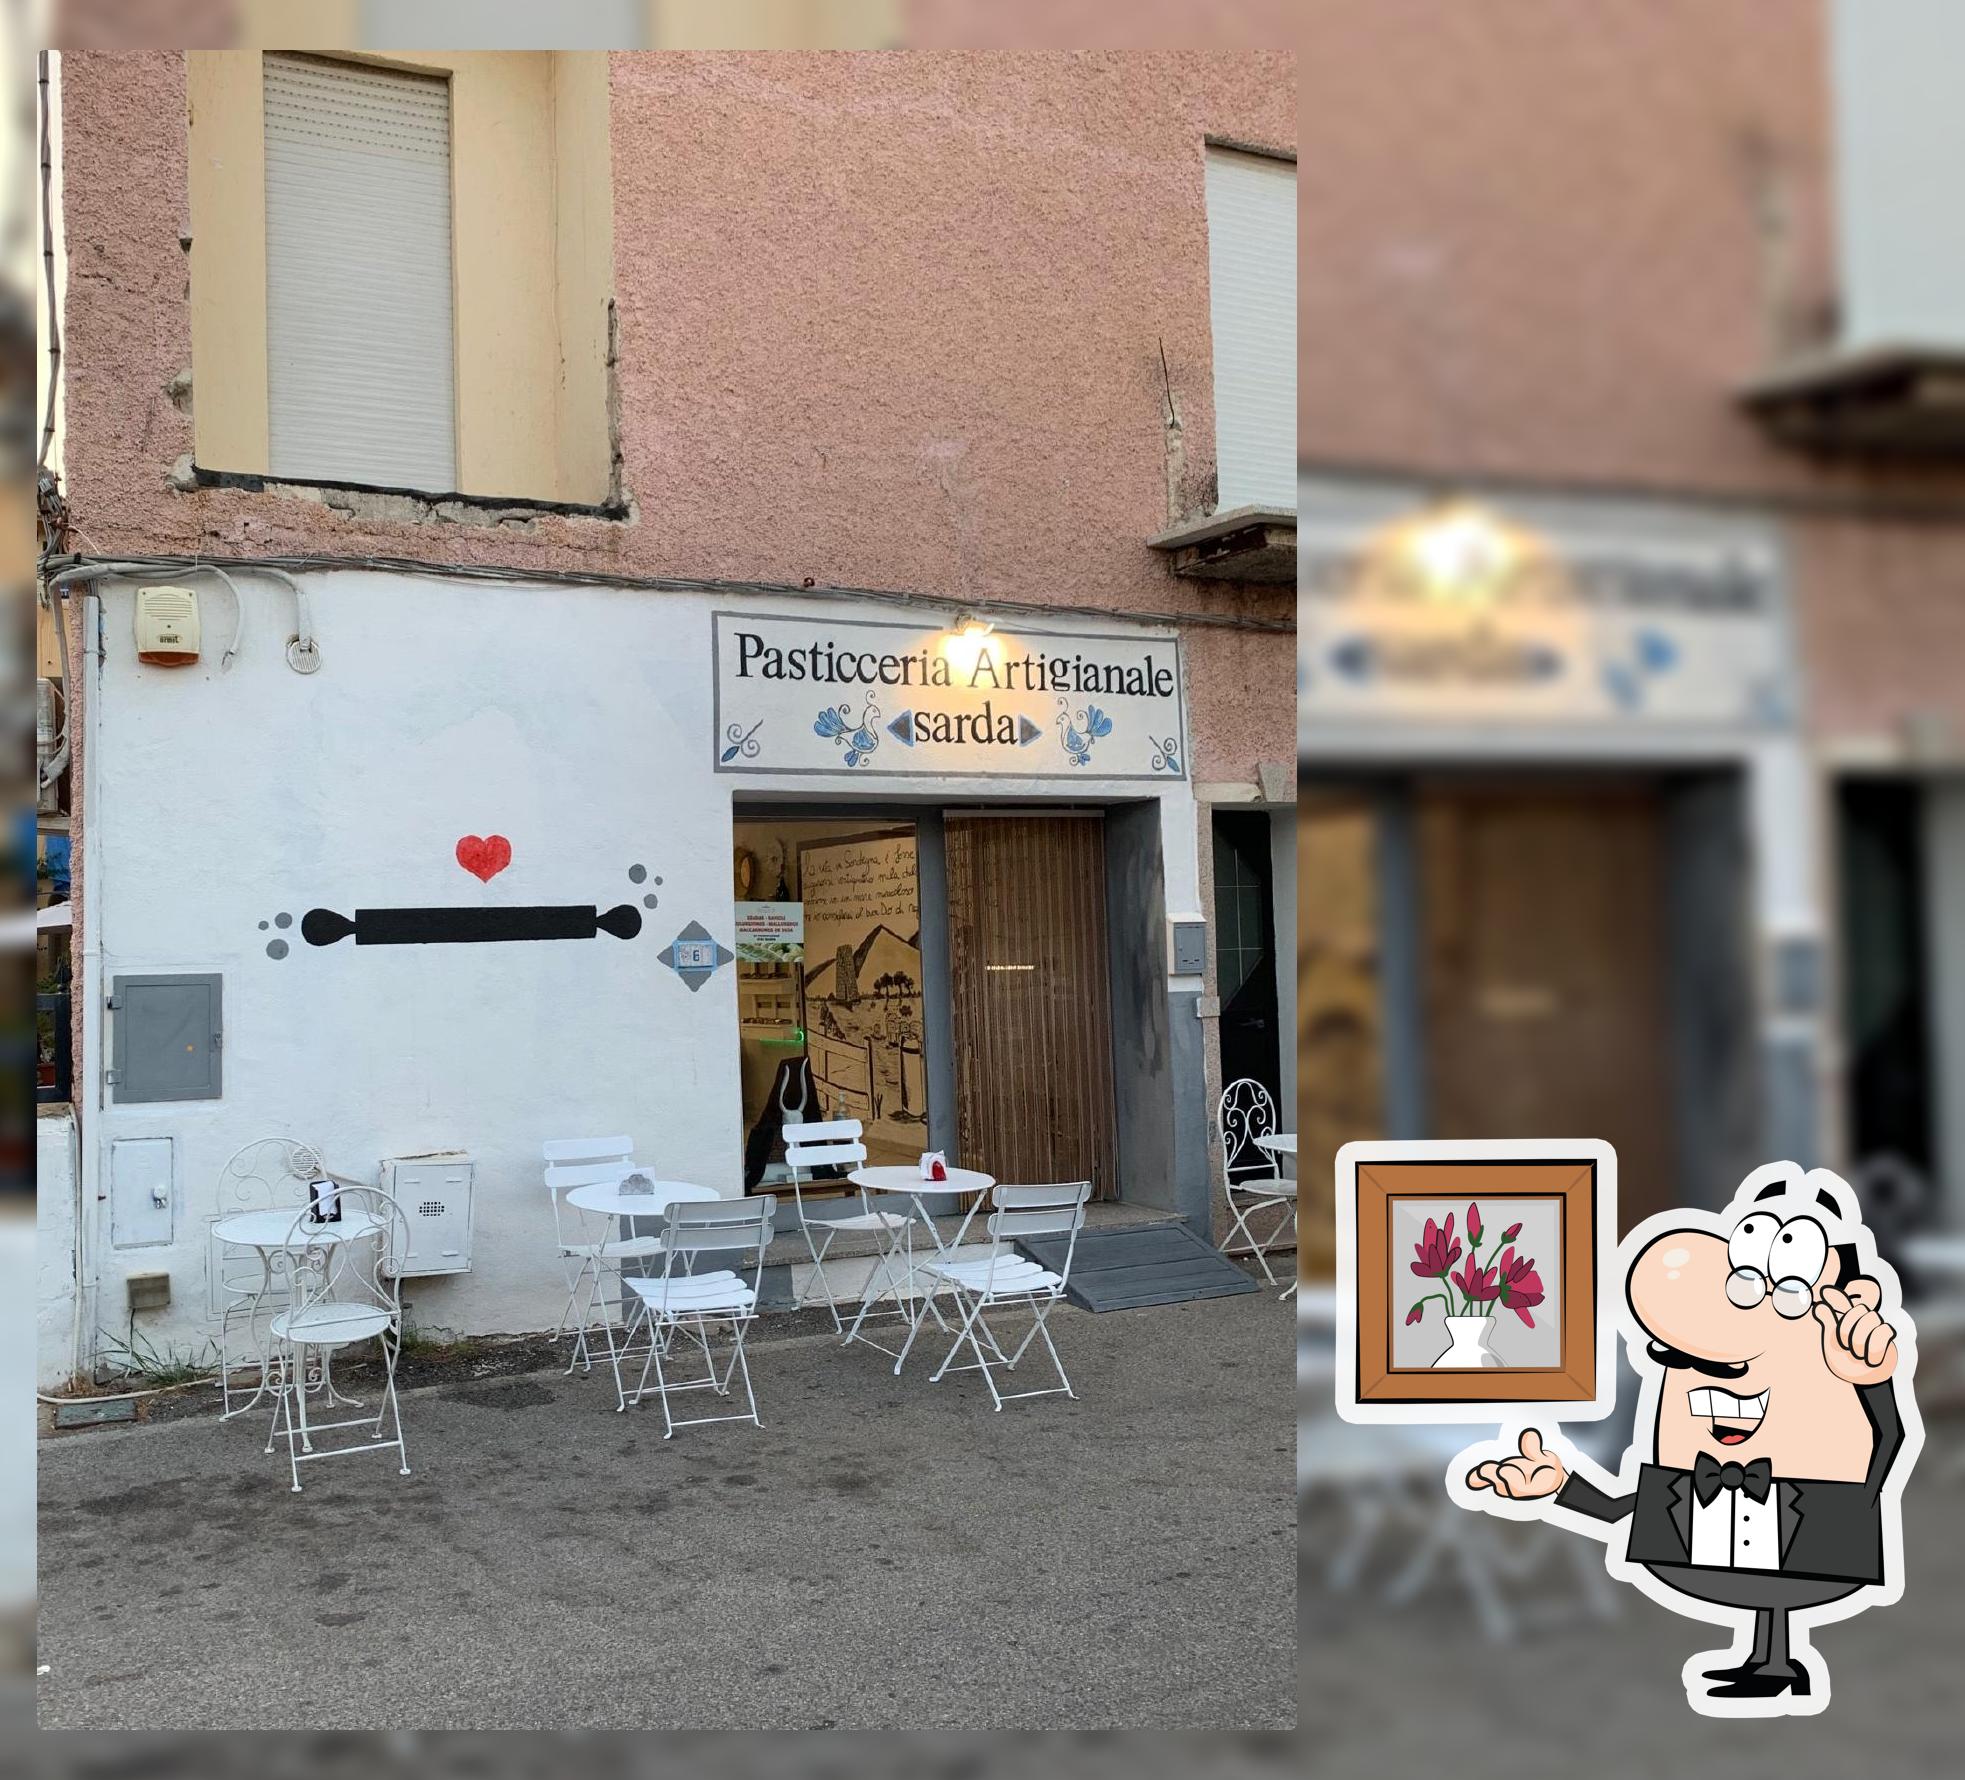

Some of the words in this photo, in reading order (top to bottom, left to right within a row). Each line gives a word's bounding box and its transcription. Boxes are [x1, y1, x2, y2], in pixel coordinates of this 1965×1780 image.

[734, 632, 951, 687] Pasticceria
[967, 648, 1174, 697] Artigianale
[915, 700, 1018, 745] sarda
[693, 950, 700, 961] 6
